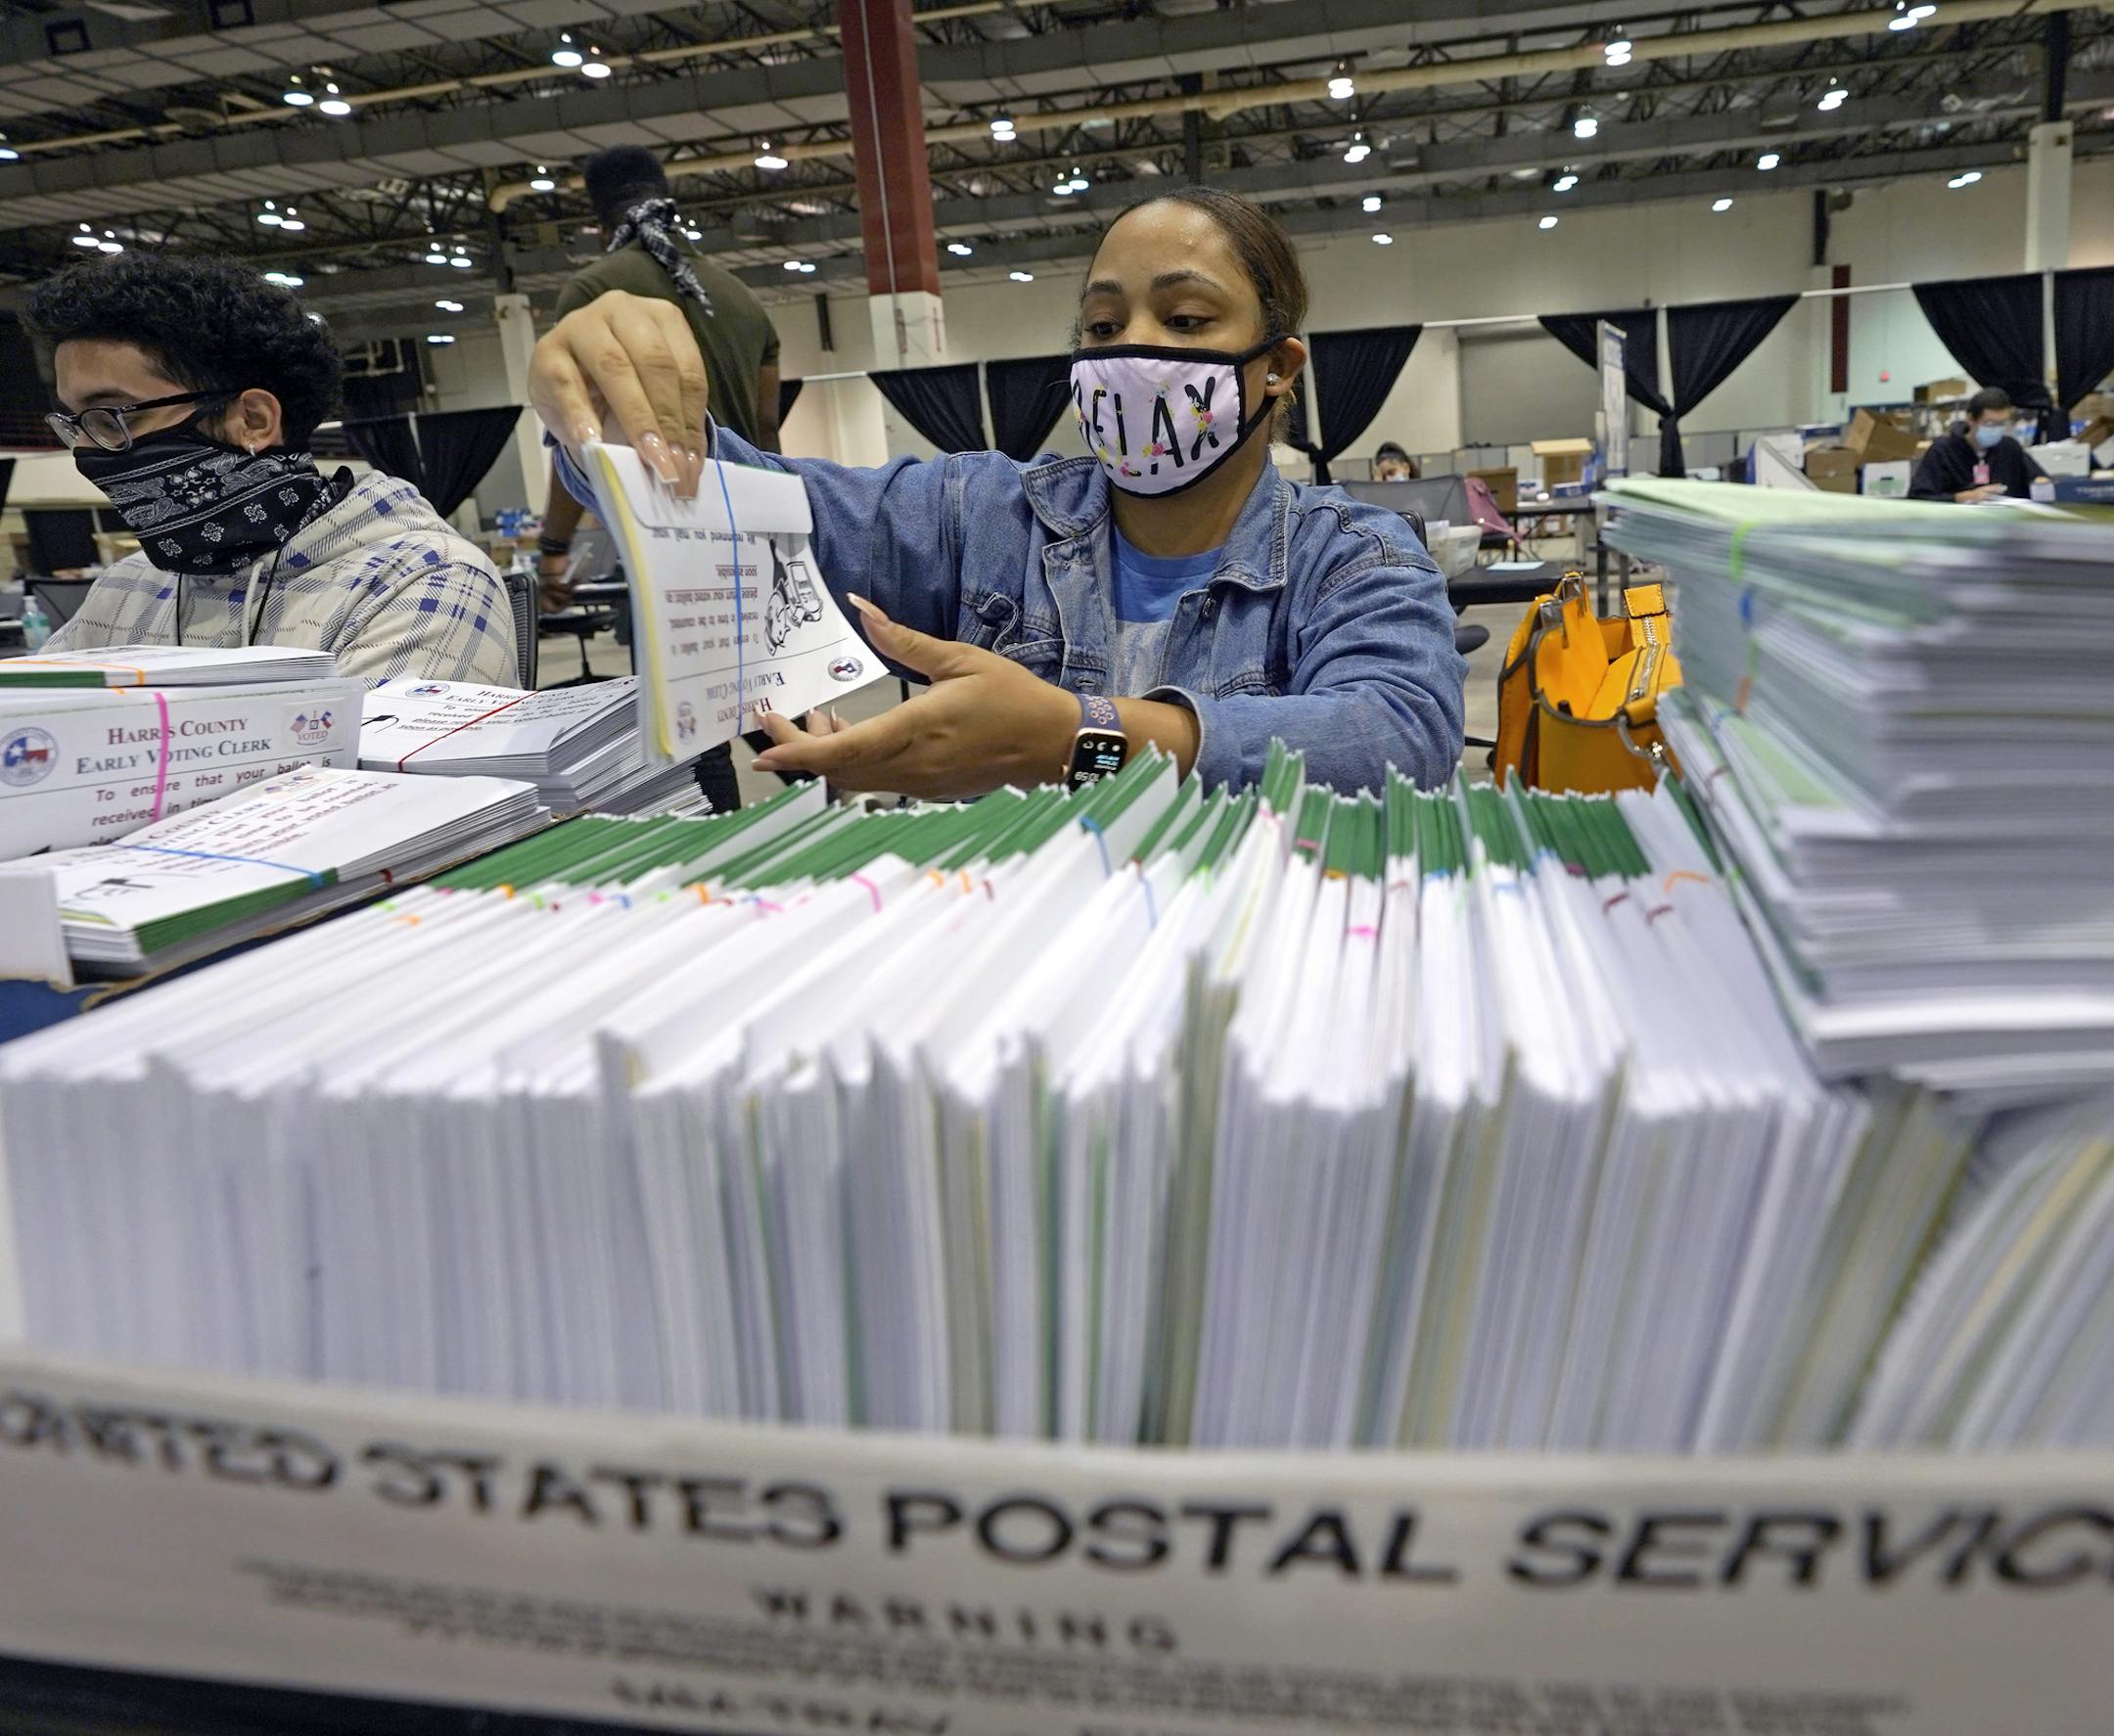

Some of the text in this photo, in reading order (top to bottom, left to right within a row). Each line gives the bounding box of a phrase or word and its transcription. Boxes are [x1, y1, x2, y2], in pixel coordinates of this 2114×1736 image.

[107, 718, 249, 746] HARRS COUNTY
[297, 730, 329, 742] VOTED
[76, 754, 140, 775] EARLY
[218, 739, 272, 757] CLERK
[95, 789, 115, 802] To
[130, 781, 181, 798] ensre
[196, 773, 223, 788] that
[236, 767, 265, 784] your
[166, 802, 181, 815] in
[358, 1439, 844, 1550] STATES
[883, 1489, 1458, 1585] POSTAL
[1505, 1501, 2114, 1595] SERVIC
